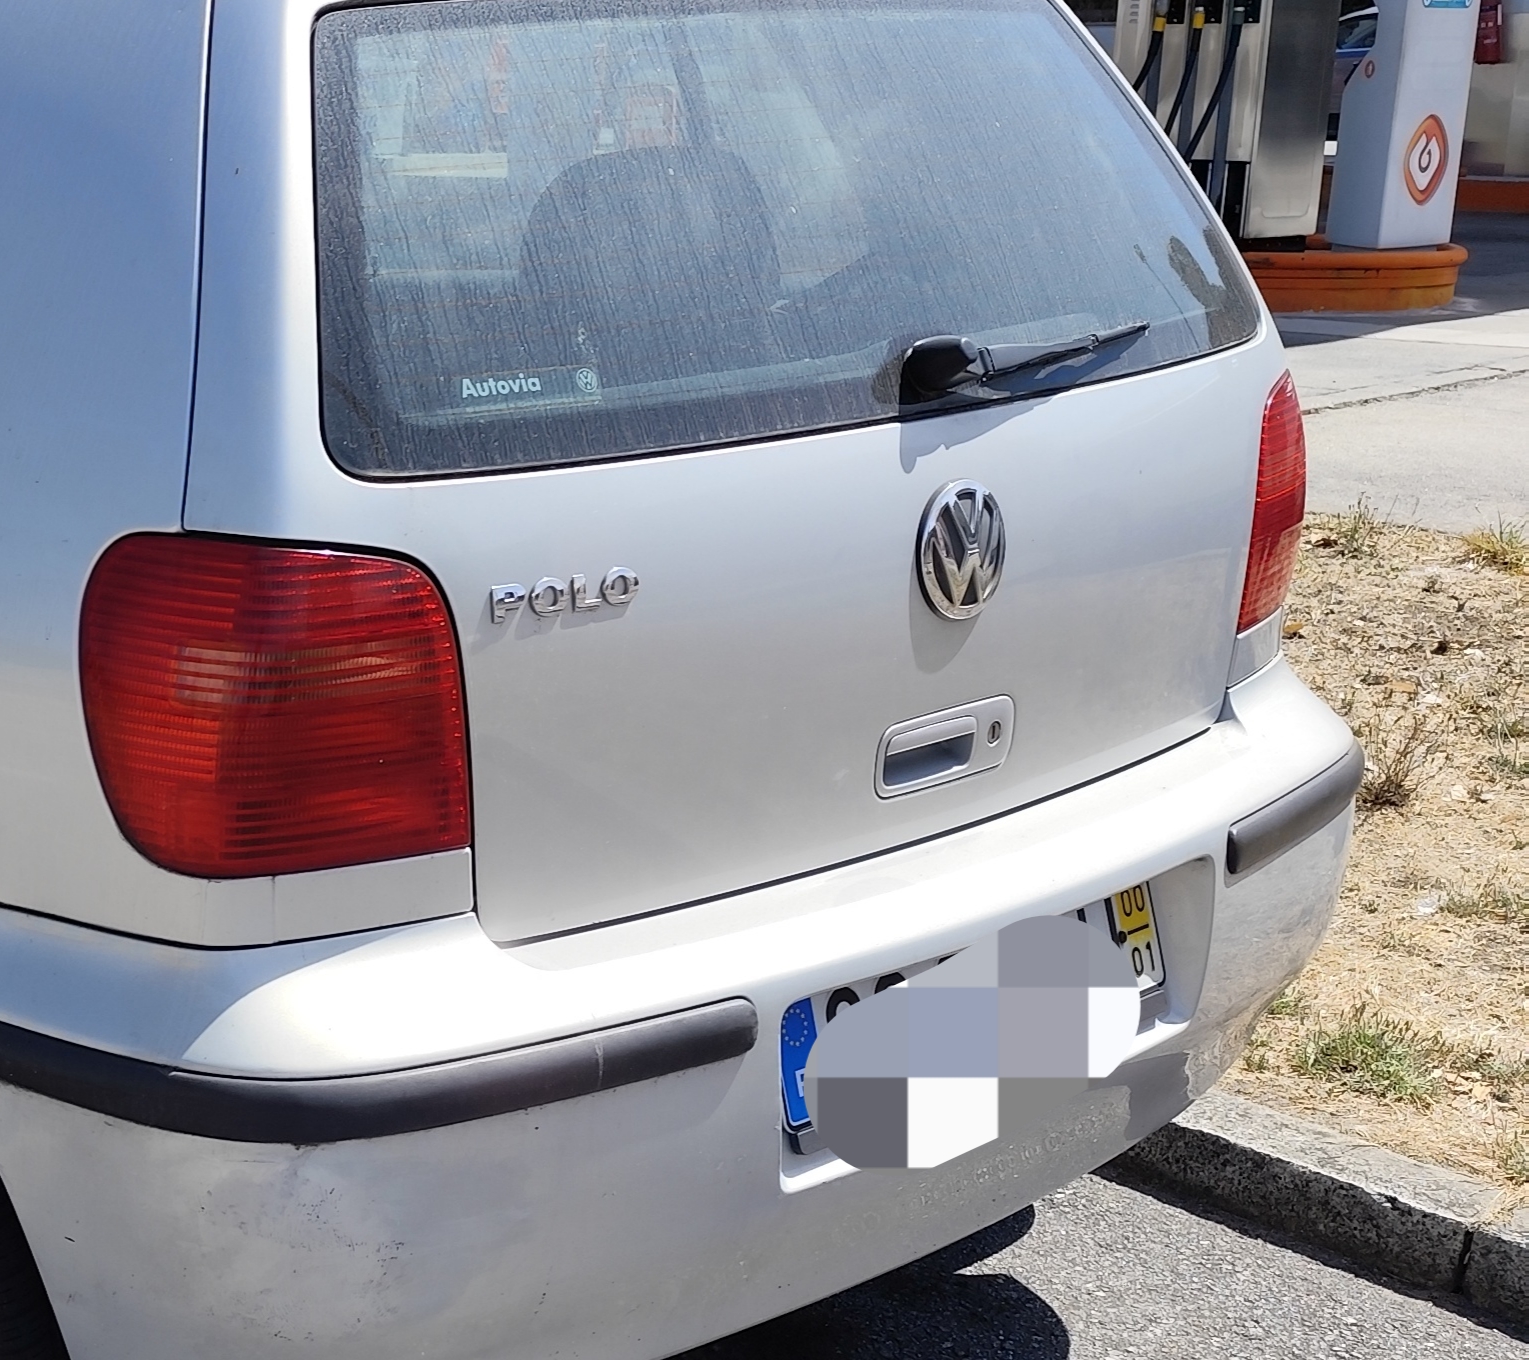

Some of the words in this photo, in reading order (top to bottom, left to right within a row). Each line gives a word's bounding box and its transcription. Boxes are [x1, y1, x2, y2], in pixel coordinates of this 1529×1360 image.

[462, 373, 542, 398] Autovia
[489, 565, 640, 625] POLO
[1131, 941, 1155, 978] 01
